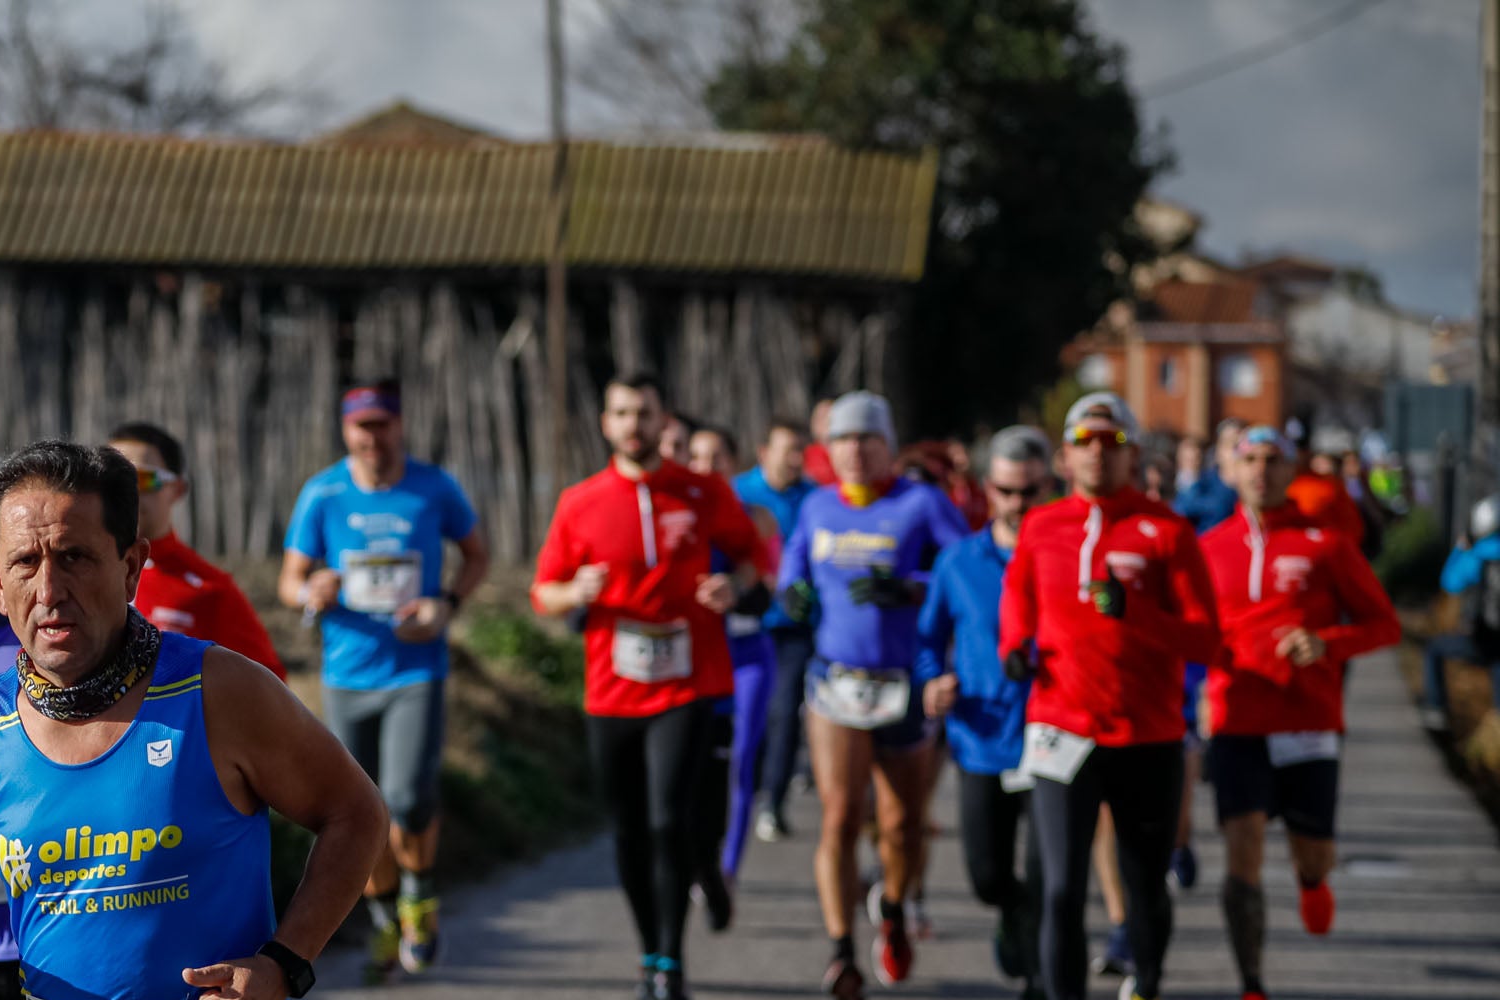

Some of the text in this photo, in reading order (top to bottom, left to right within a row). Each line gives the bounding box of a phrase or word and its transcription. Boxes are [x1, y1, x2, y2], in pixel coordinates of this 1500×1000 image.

[38, 825, 183, 864] olimpo
[40, 863, 126, 886] deportes
[39, 883, 190, 915] TRAIL & RUNNING
